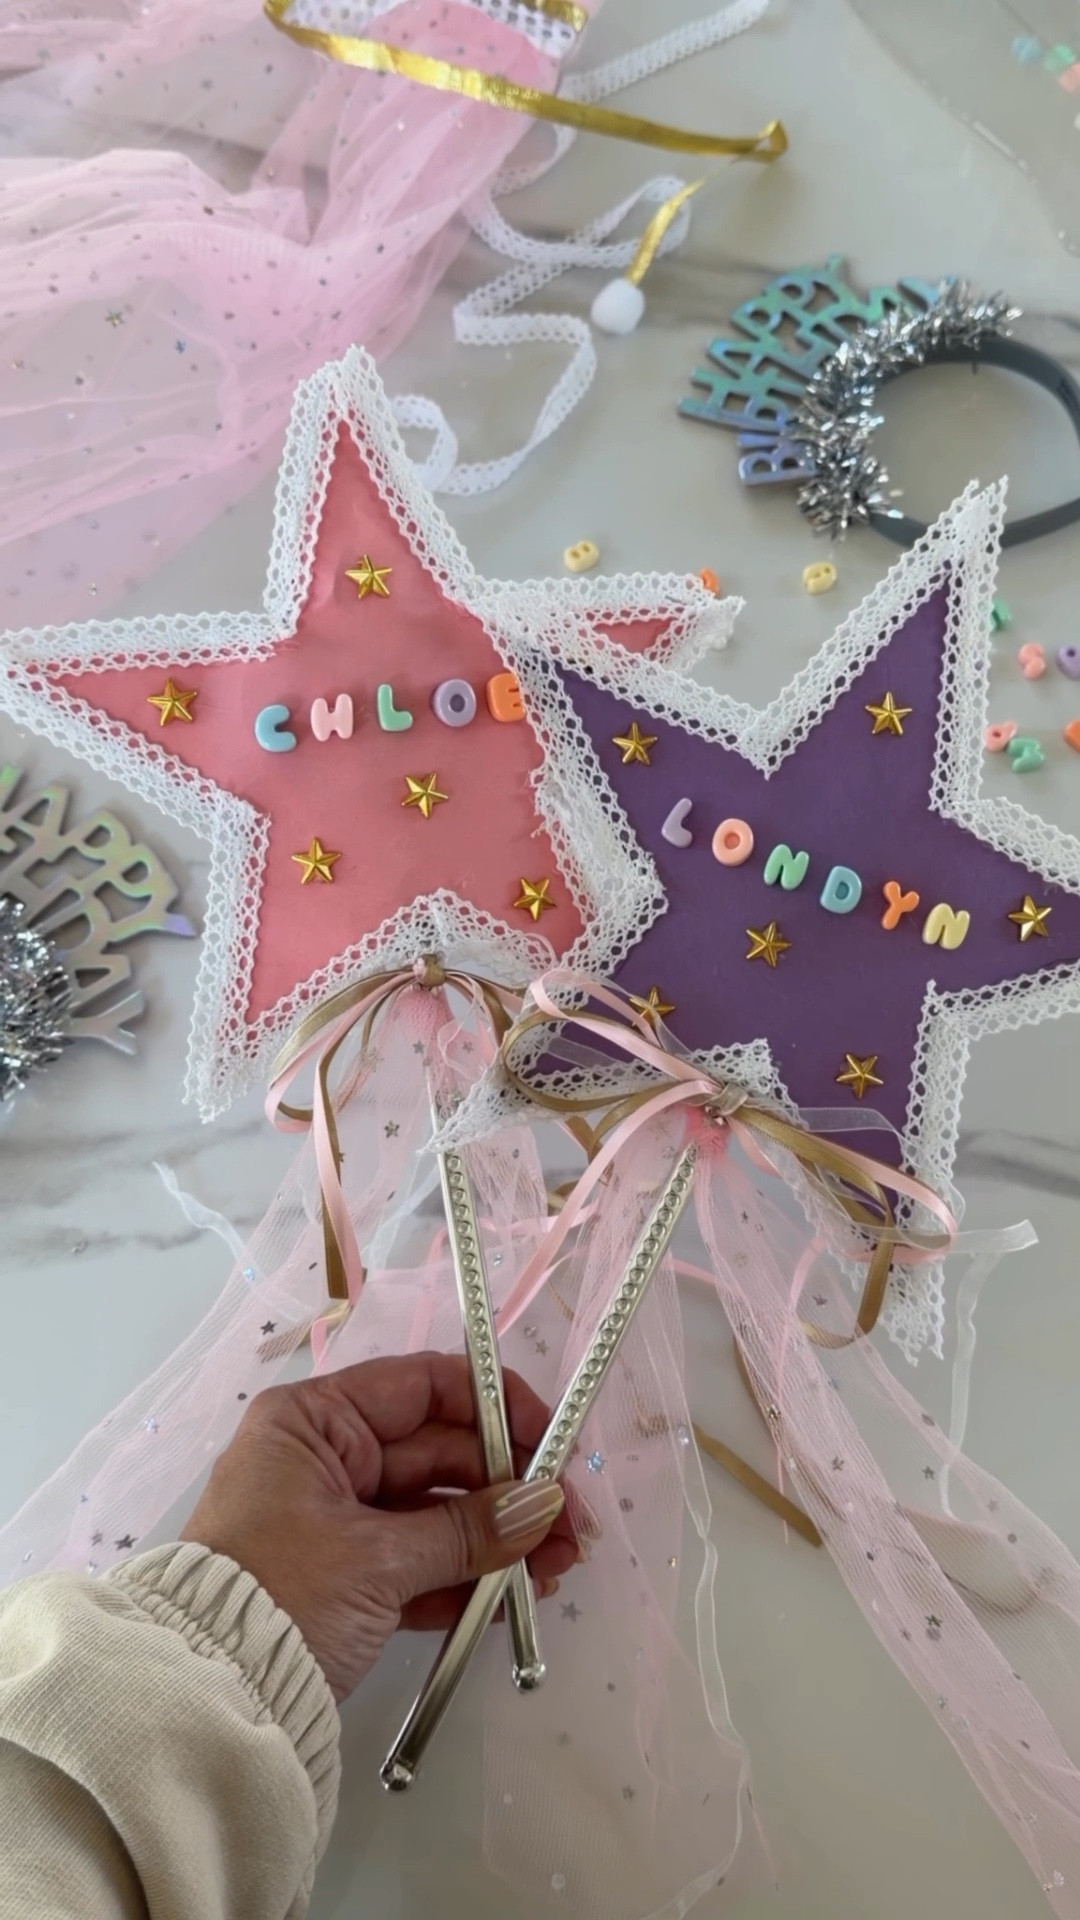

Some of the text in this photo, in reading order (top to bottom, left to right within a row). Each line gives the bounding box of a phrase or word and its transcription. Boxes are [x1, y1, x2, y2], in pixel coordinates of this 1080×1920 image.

[677, 253, 860, 432] HAPPY
[254, 671, 527, 753] CHLOE
[661, 797, 971, 950] LONDYN
